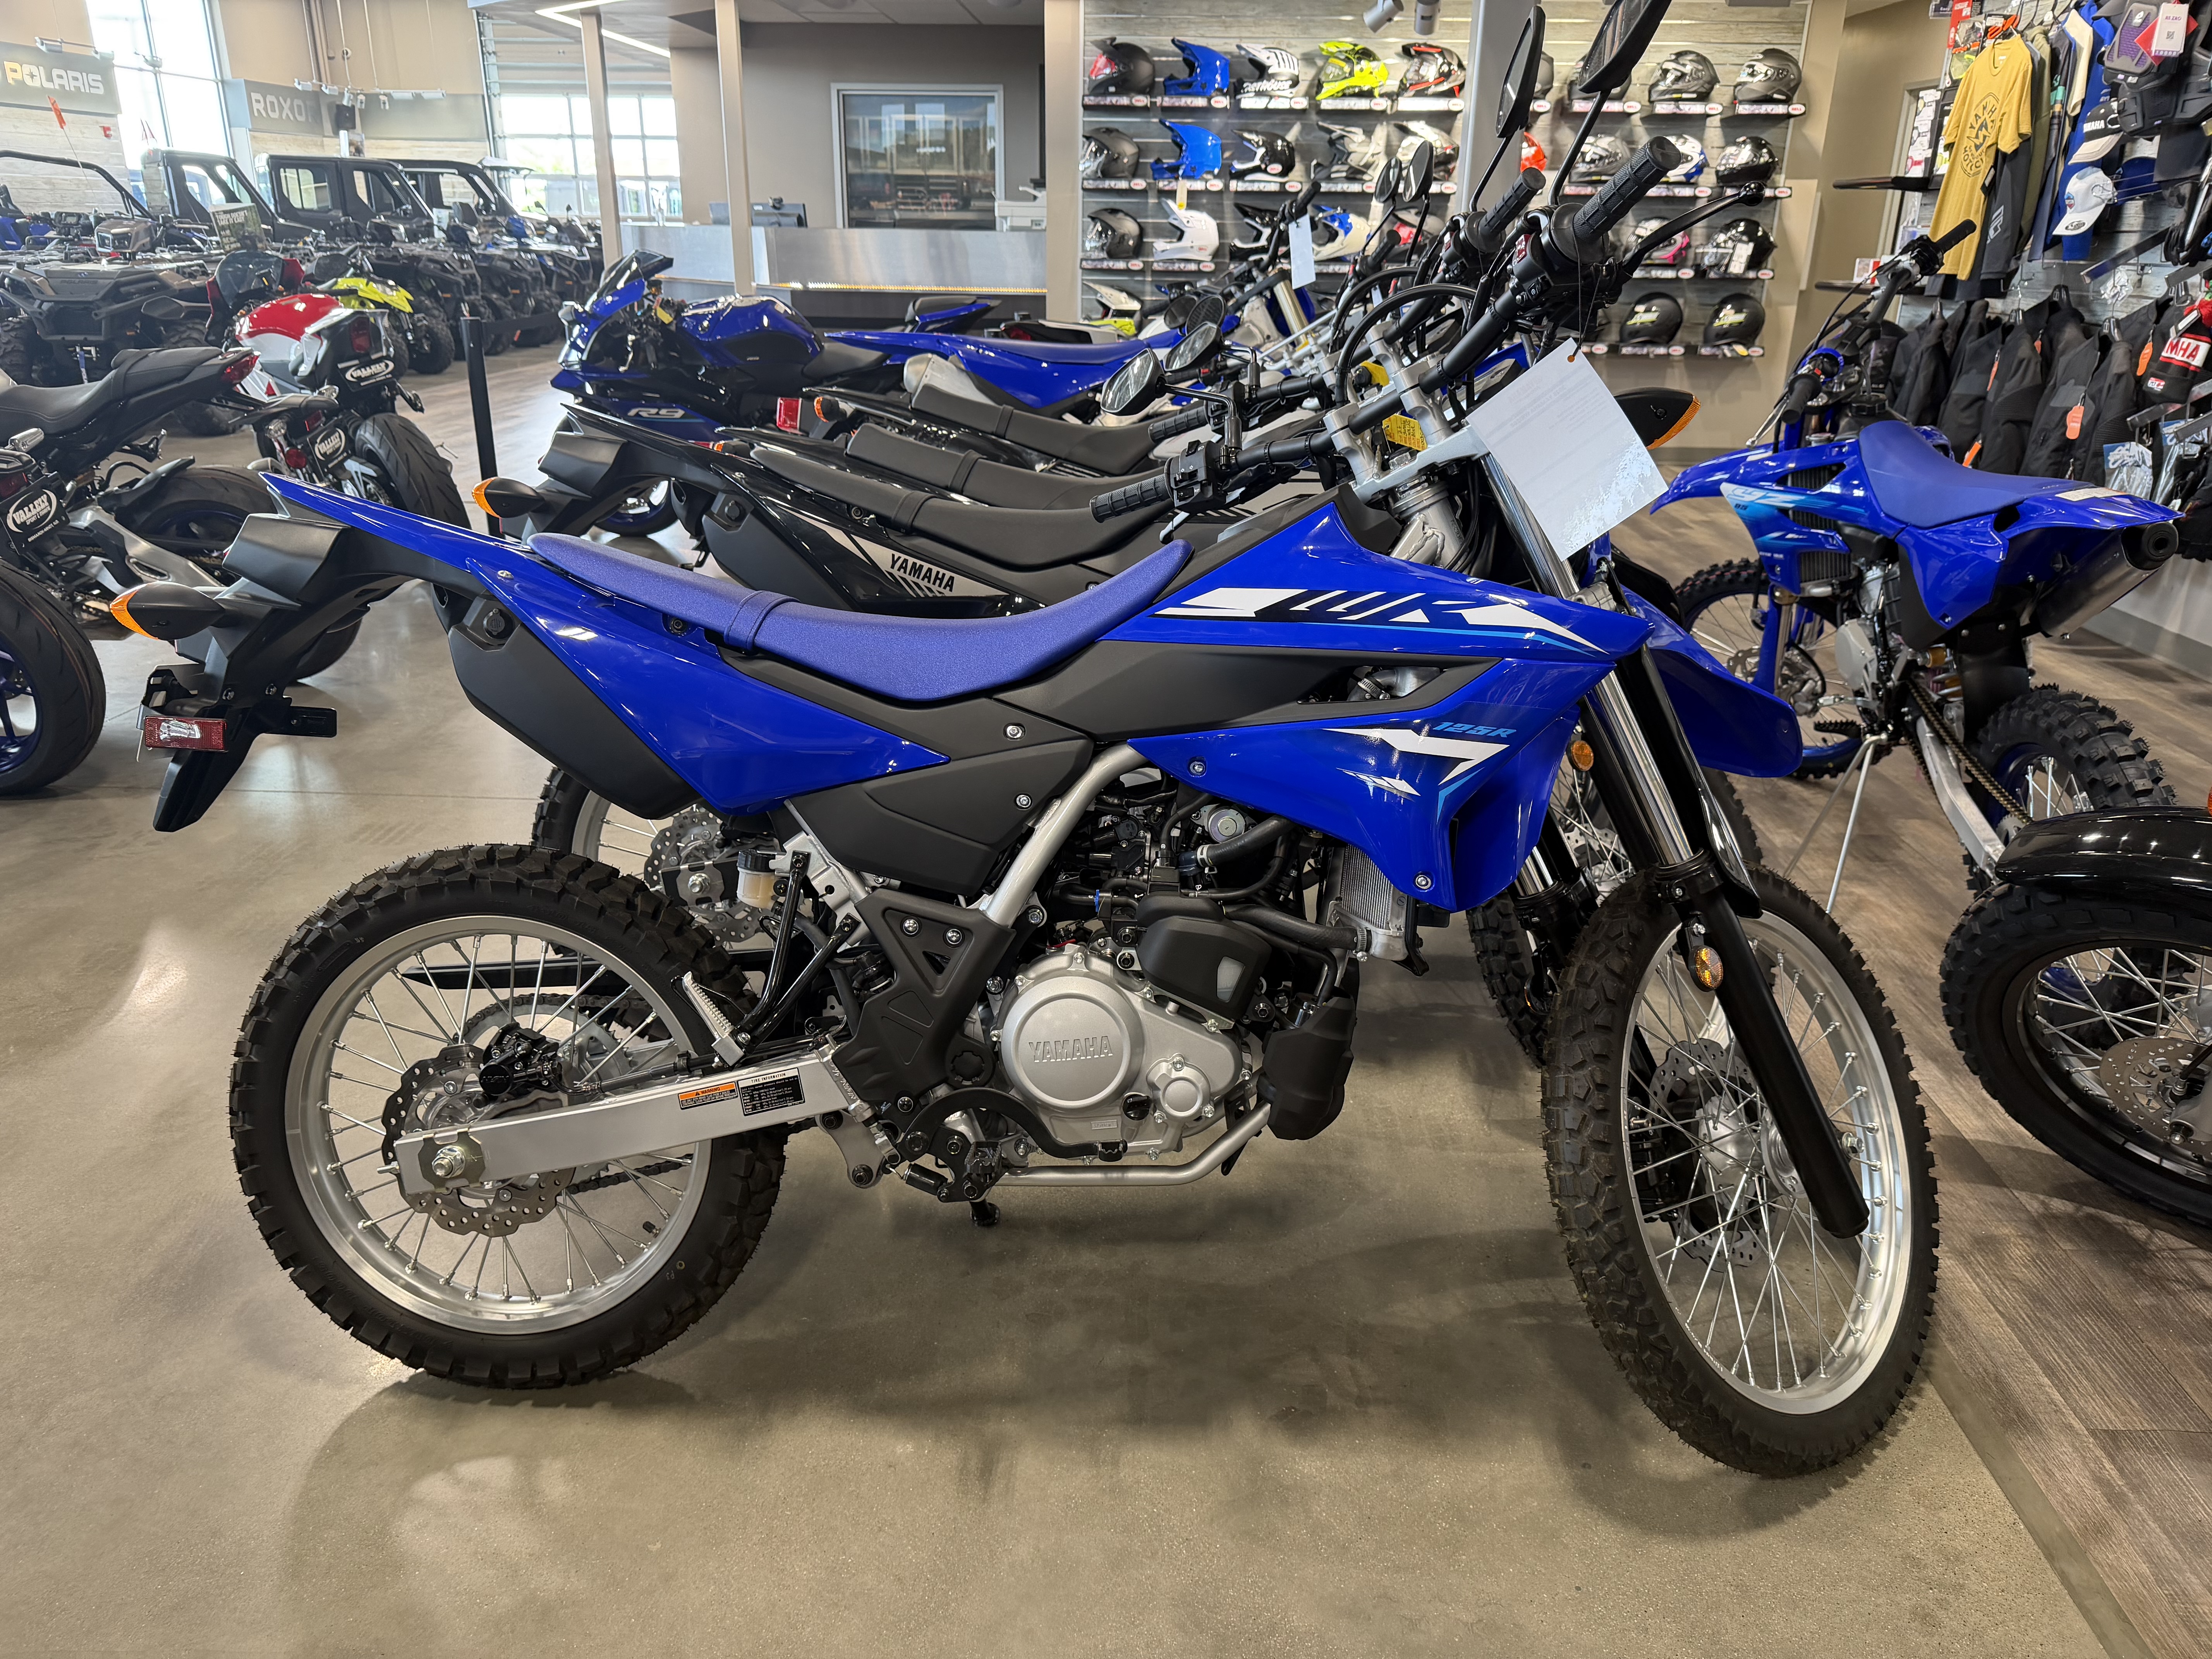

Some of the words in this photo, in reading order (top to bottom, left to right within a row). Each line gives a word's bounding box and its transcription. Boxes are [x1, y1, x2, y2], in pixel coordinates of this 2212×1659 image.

[4, 61, 104, 94] POLARIS
[627, 408, 685, 418] R9
[12, 494, 49, 525] VALLELY
[1726, 487, 1806, 508] YZ
[890, 553, 955, 592] YAMAHA
[1432, 722, 1517, 738] 125R
[1029, 1036, 1113, 1063] YAMAHA
[761, 1073, 786, 1082] INFORMATION
